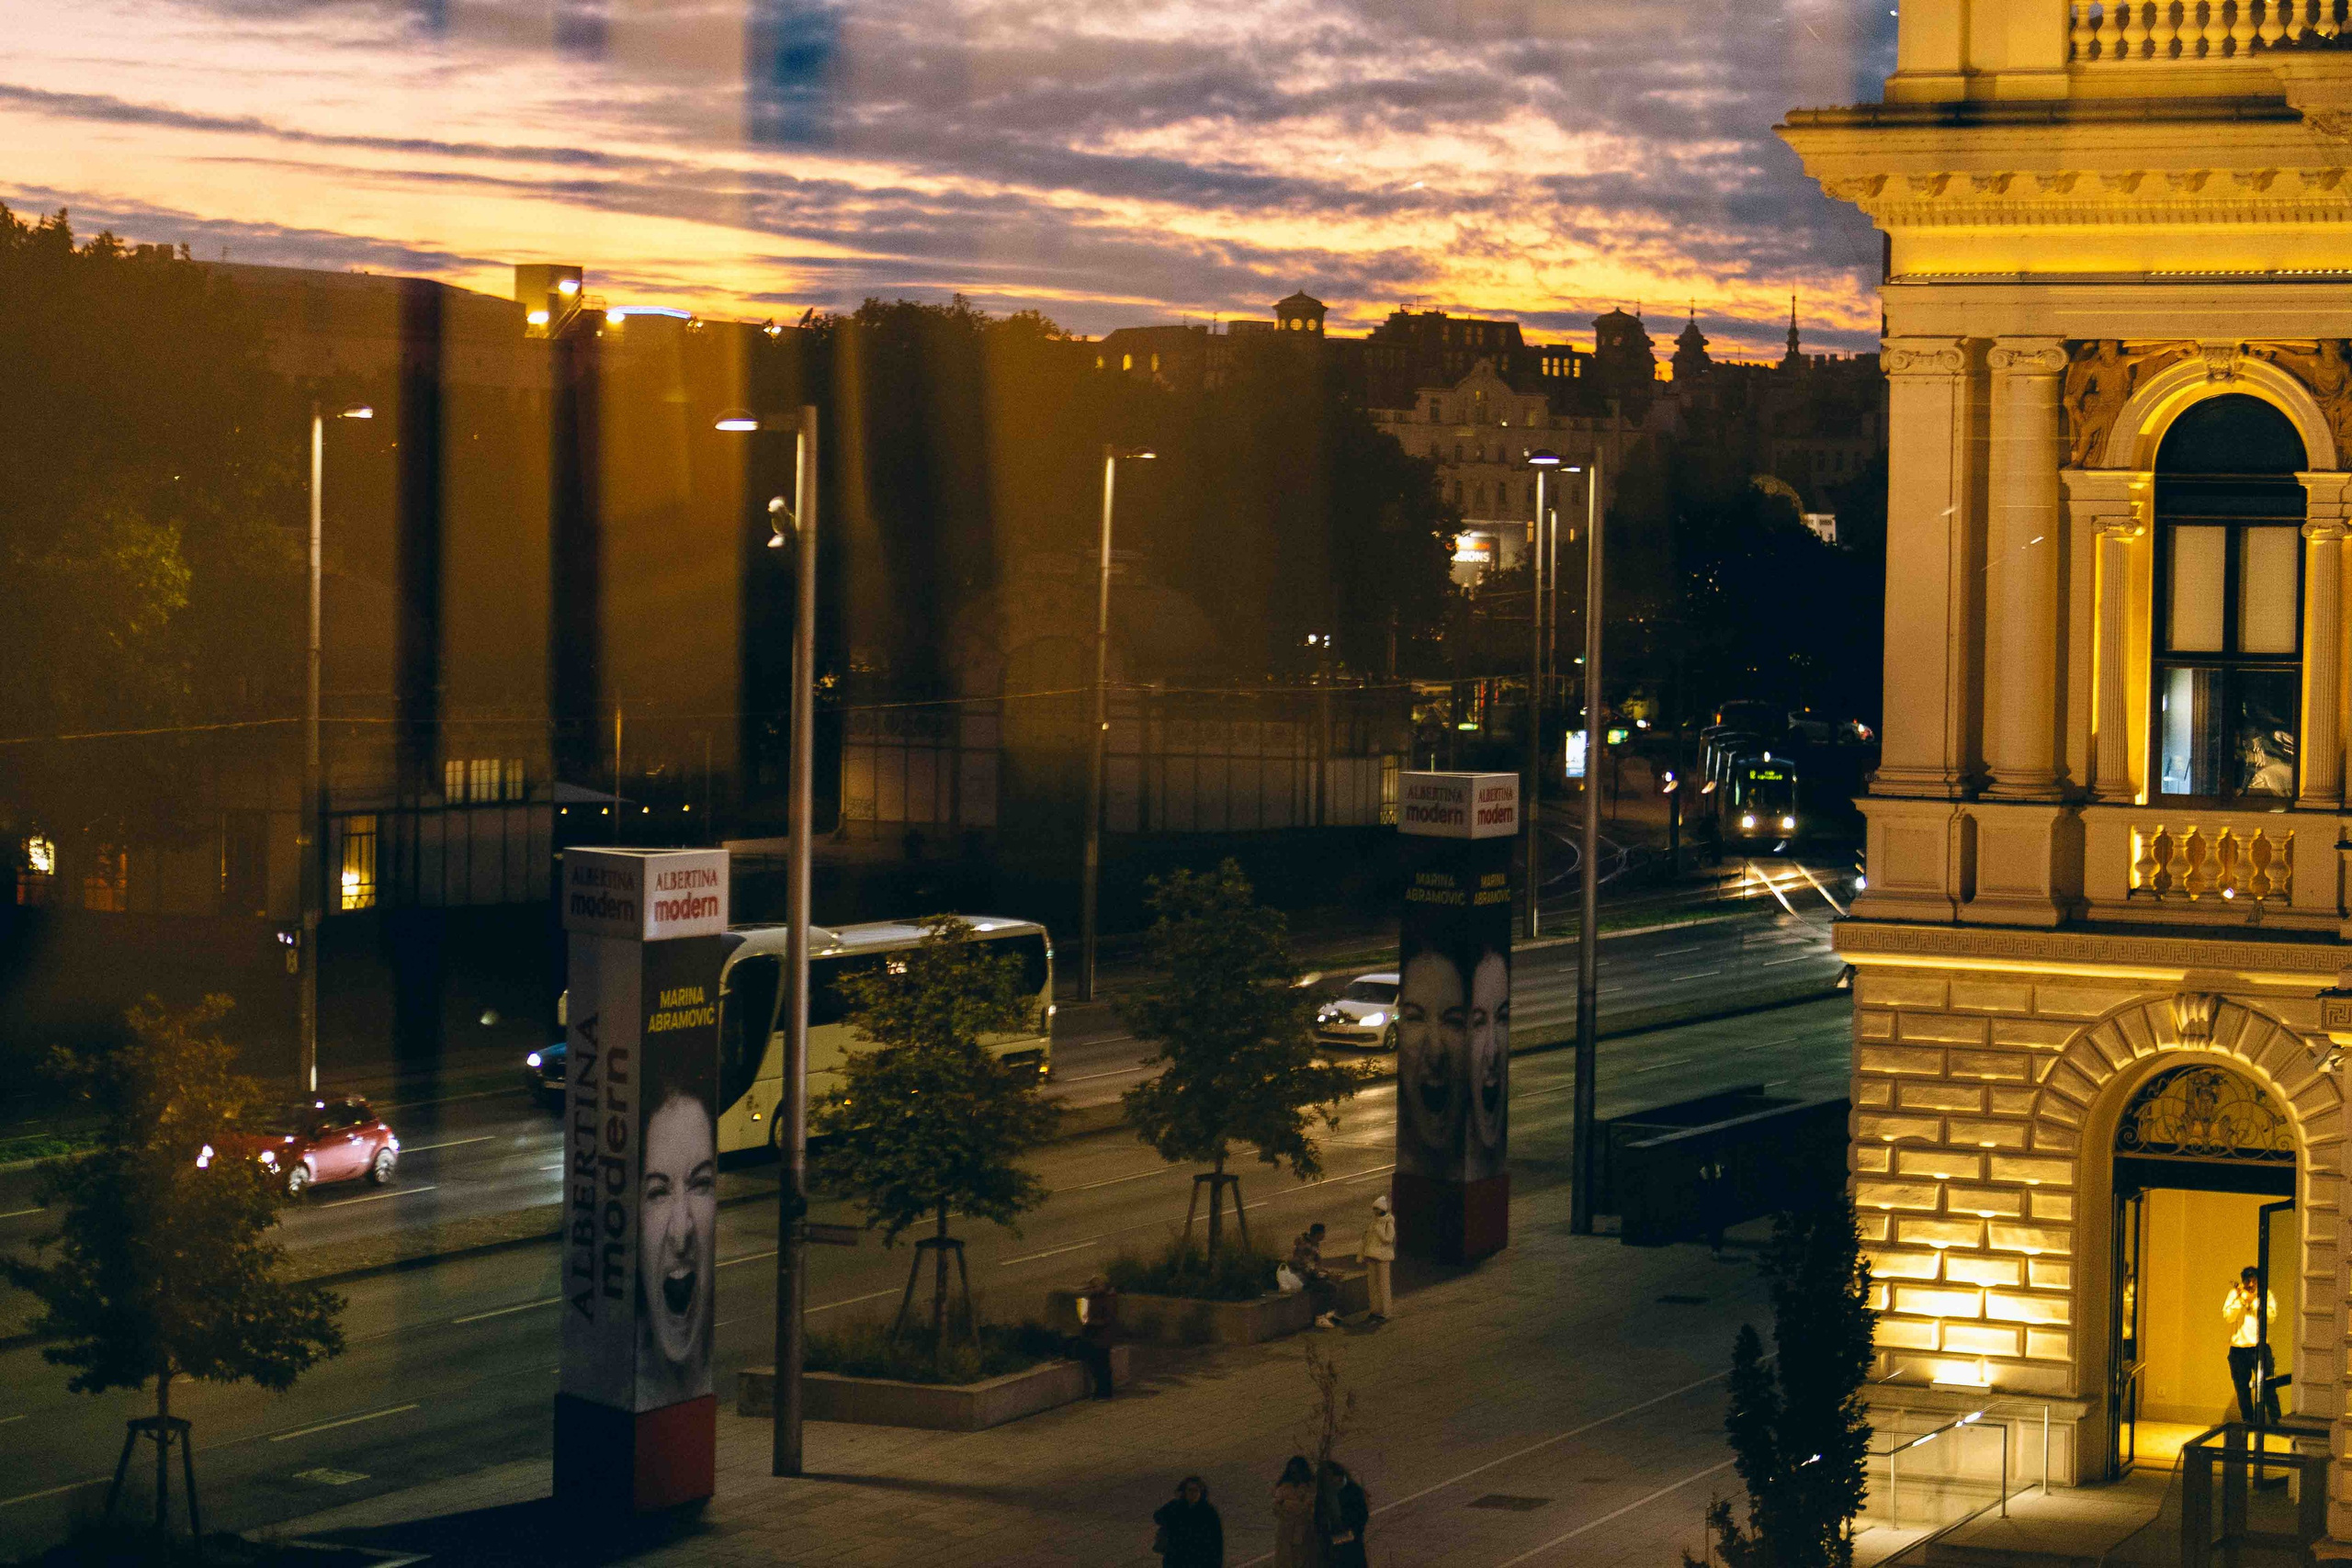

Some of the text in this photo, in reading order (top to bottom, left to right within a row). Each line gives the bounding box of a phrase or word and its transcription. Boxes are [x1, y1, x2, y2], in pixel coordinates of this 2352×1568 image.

[1408, 785, 1463, 804] ALBERTINA
[1478, 787, 1513, 804] ALBERTINA
[1406, 804, 1464, 826] modern
[1476, 804, 1513, 826] modern
[571, 865, 635, 892] ALBERTINA
[655, 869, 718, 892] ALBERTINA
[1415, 873, 1455, 888] MARINA
[1480, 874, 1506, 888] MARINA
[571, 891, 635, 921] modern
[654, 892, 718, 922] modern
[660, 986, 705, 1009] MARINA
[648, 1002, 716, 1033] ABRAMOVIĆ
[571, 1012, 598, 1321] ALBERTINA
[599, 1046, 628, 1301] modern
